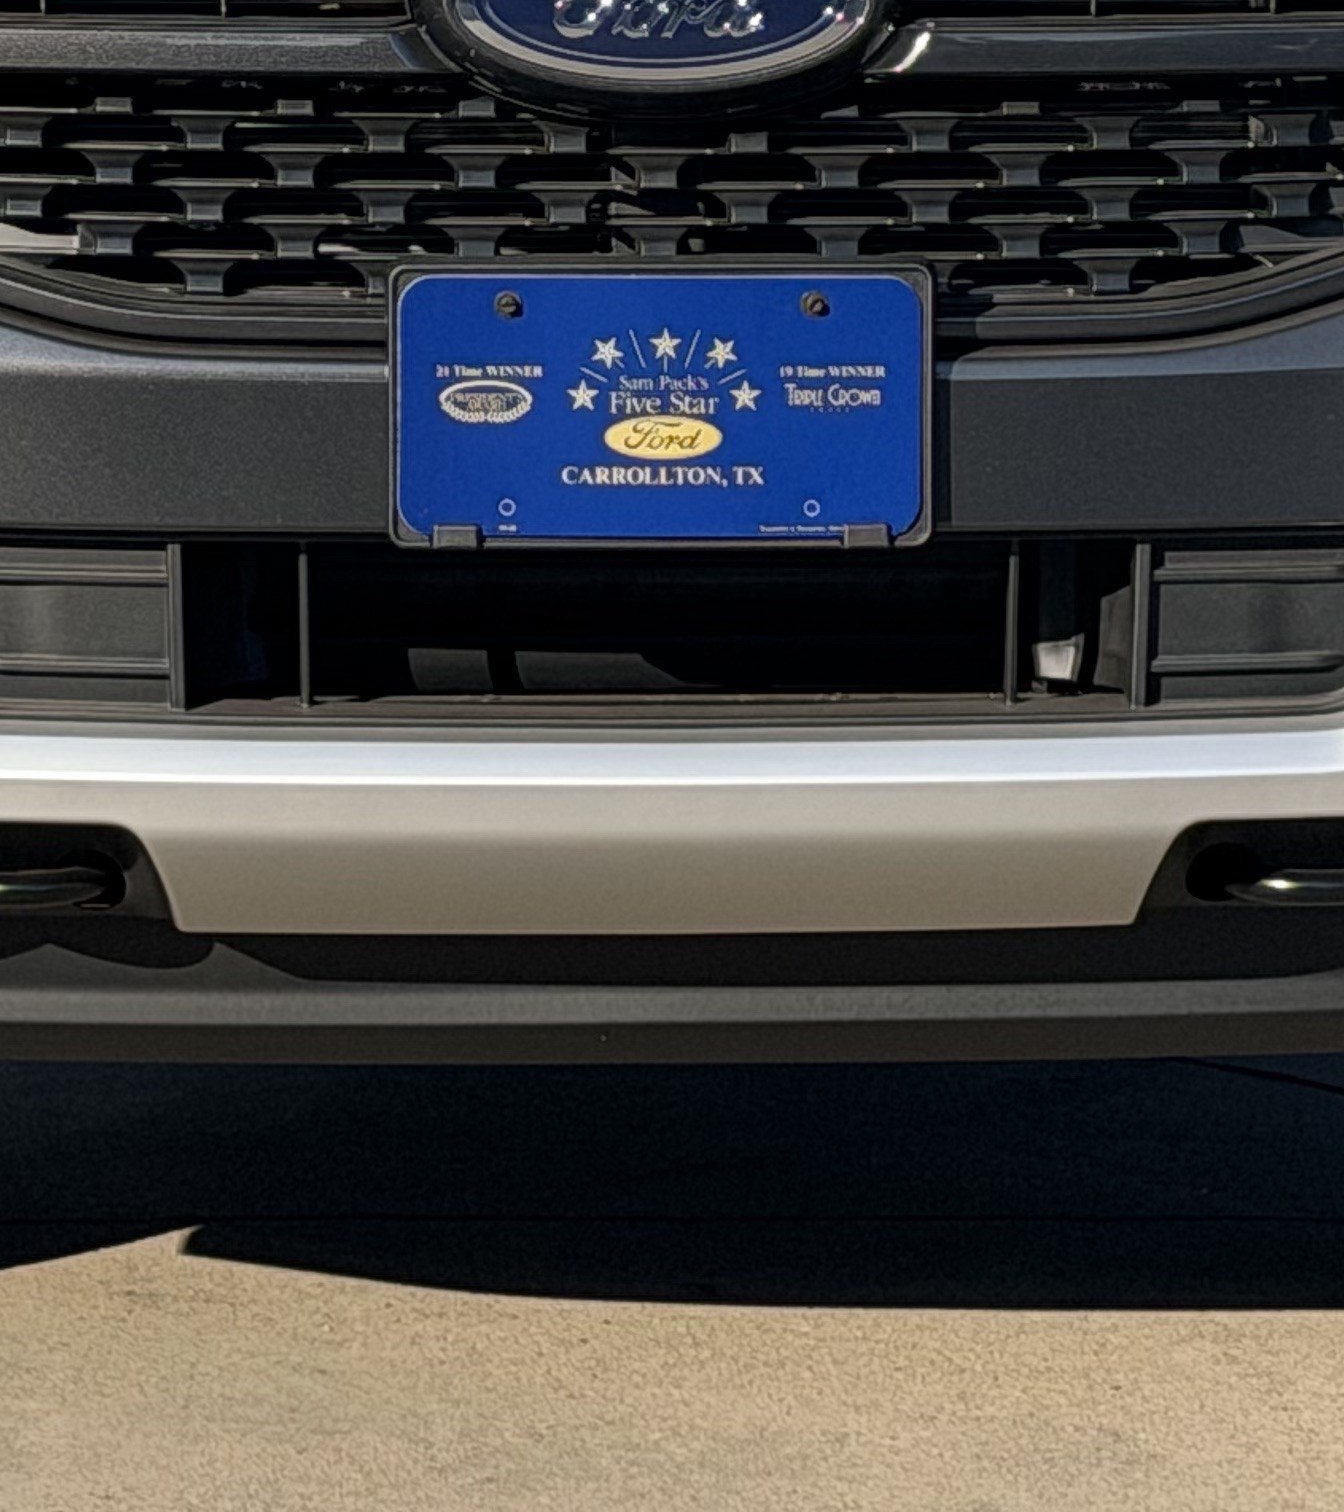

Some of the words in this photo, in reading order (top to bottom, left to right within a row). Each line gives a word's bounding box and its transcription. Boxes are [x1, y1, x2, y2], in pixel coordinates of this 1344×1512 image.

[485, 365, 544, 378] WINNER
[827, 365, 886, 378] WINNER
[618, 374, 654, 391] Sam
[609, 391, 662, 415] Five
[668, 391, 721, 415] Star
[623, 419, 703, 451] Ford
[561, 465, 729, 488] CARROLLTON,
[732, 465, 766, 486] TX
